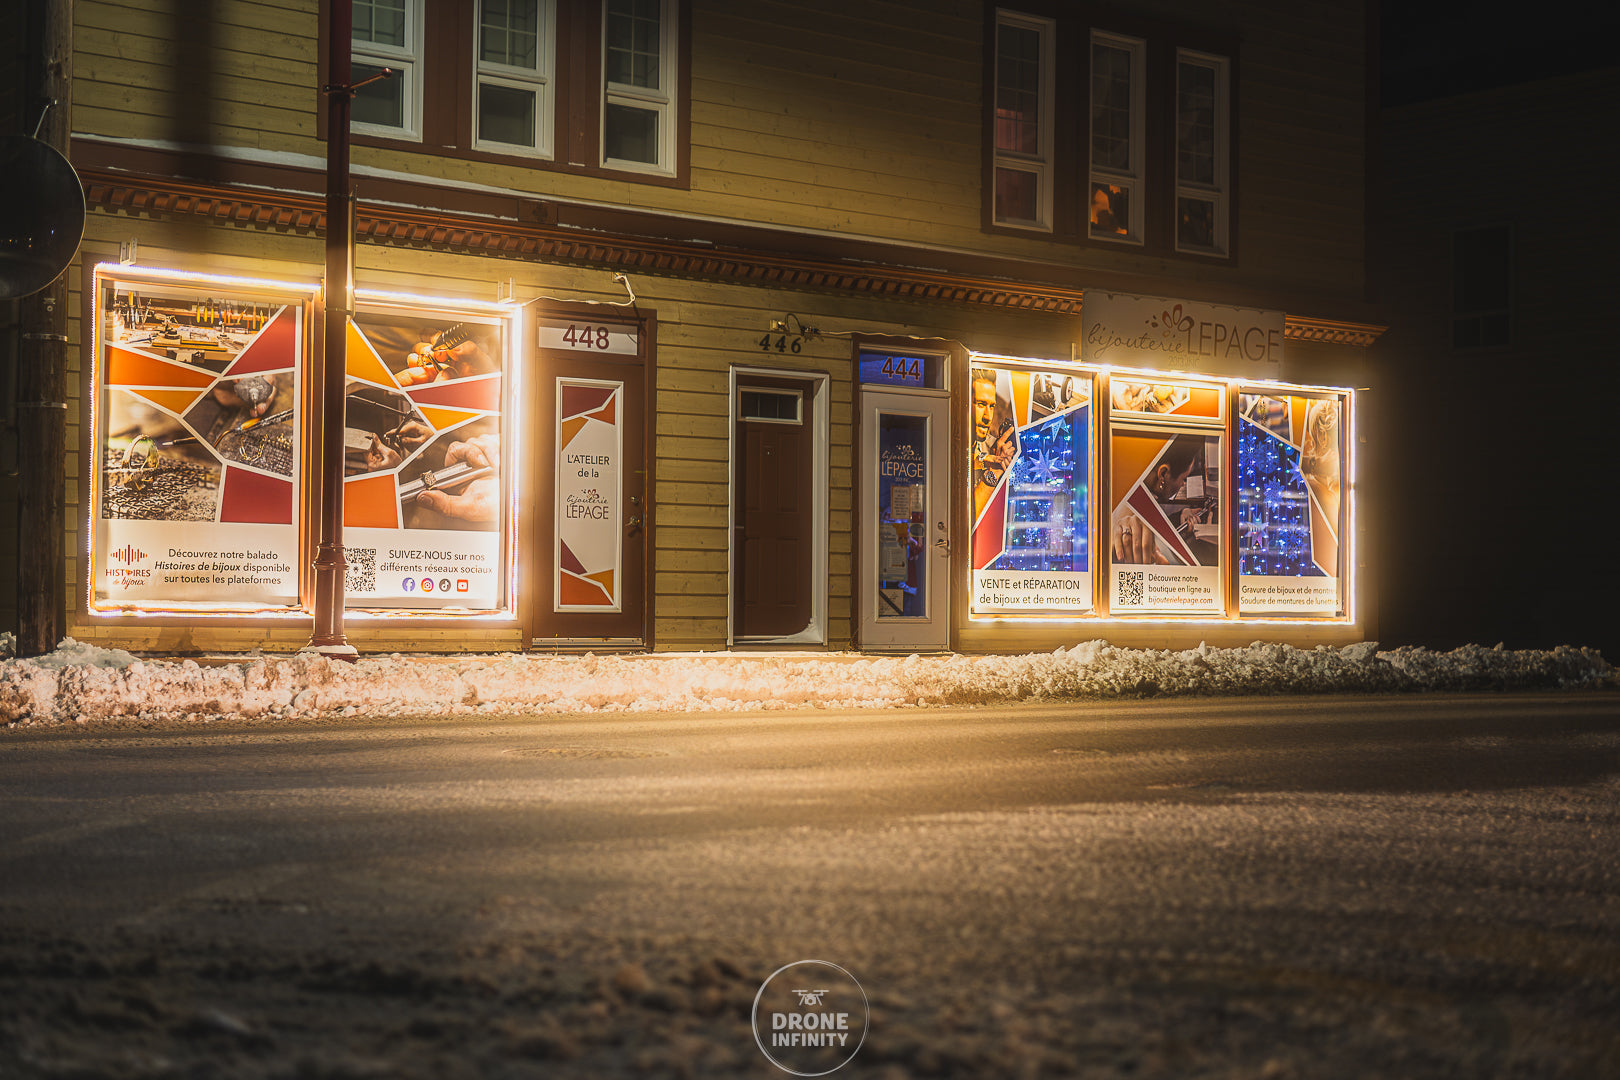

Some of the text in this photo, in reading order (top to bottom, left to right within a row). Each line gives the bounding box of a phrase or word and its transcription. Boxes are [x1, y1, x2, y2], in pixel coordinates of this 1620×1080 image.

[562, 324, 609, 350] 448
[1088, 321, 1279, 363] bijouterie LEPAGE
[759, 334, 802, 353] 446
[881, 357, 921, 381] 444
[568, 454, 610, 465] L'ATELIER
[578, 468, 599, 478] de la
[882, 462, 924, 478] LEPAGE
[566, 494, 608, 507] bijouterie
[566, 505, 608, 520] LEPAGE
[168, 548, 218, 558] Découvrez
[247, 550, 278, 560] balado
[389, 550, 452, 560] SUIVEZ-NOUS
[454, 553, 467, 561] sur
[154, 561, 291, 576] Histoires de bijoux disponible
[380, 562, 493, 574] différents réseaux sociaux
[164, 574, 282, 586] sur toutes les plateformes
[980, 577, 1080, 590] VENTE et RÉPARATION
[1148, 574, 1180, 582] Découvrez
[1148, 585, 1176, 594] boutique
[1186, 586, 1202, 595] ligne
[1241, 586, 1266, 594] Gravure
[1268, 586, 1276, 594] de
[1276, 586, 1296, 596] bijoux
[980, 594, 1081, 606] de bijoux et de montres
[1148, 596, 1213, 605] bijouterielepage.com
[1240, 596, 1266, 605] Soudure
[1315, 597, 1338, 605] lunetts
